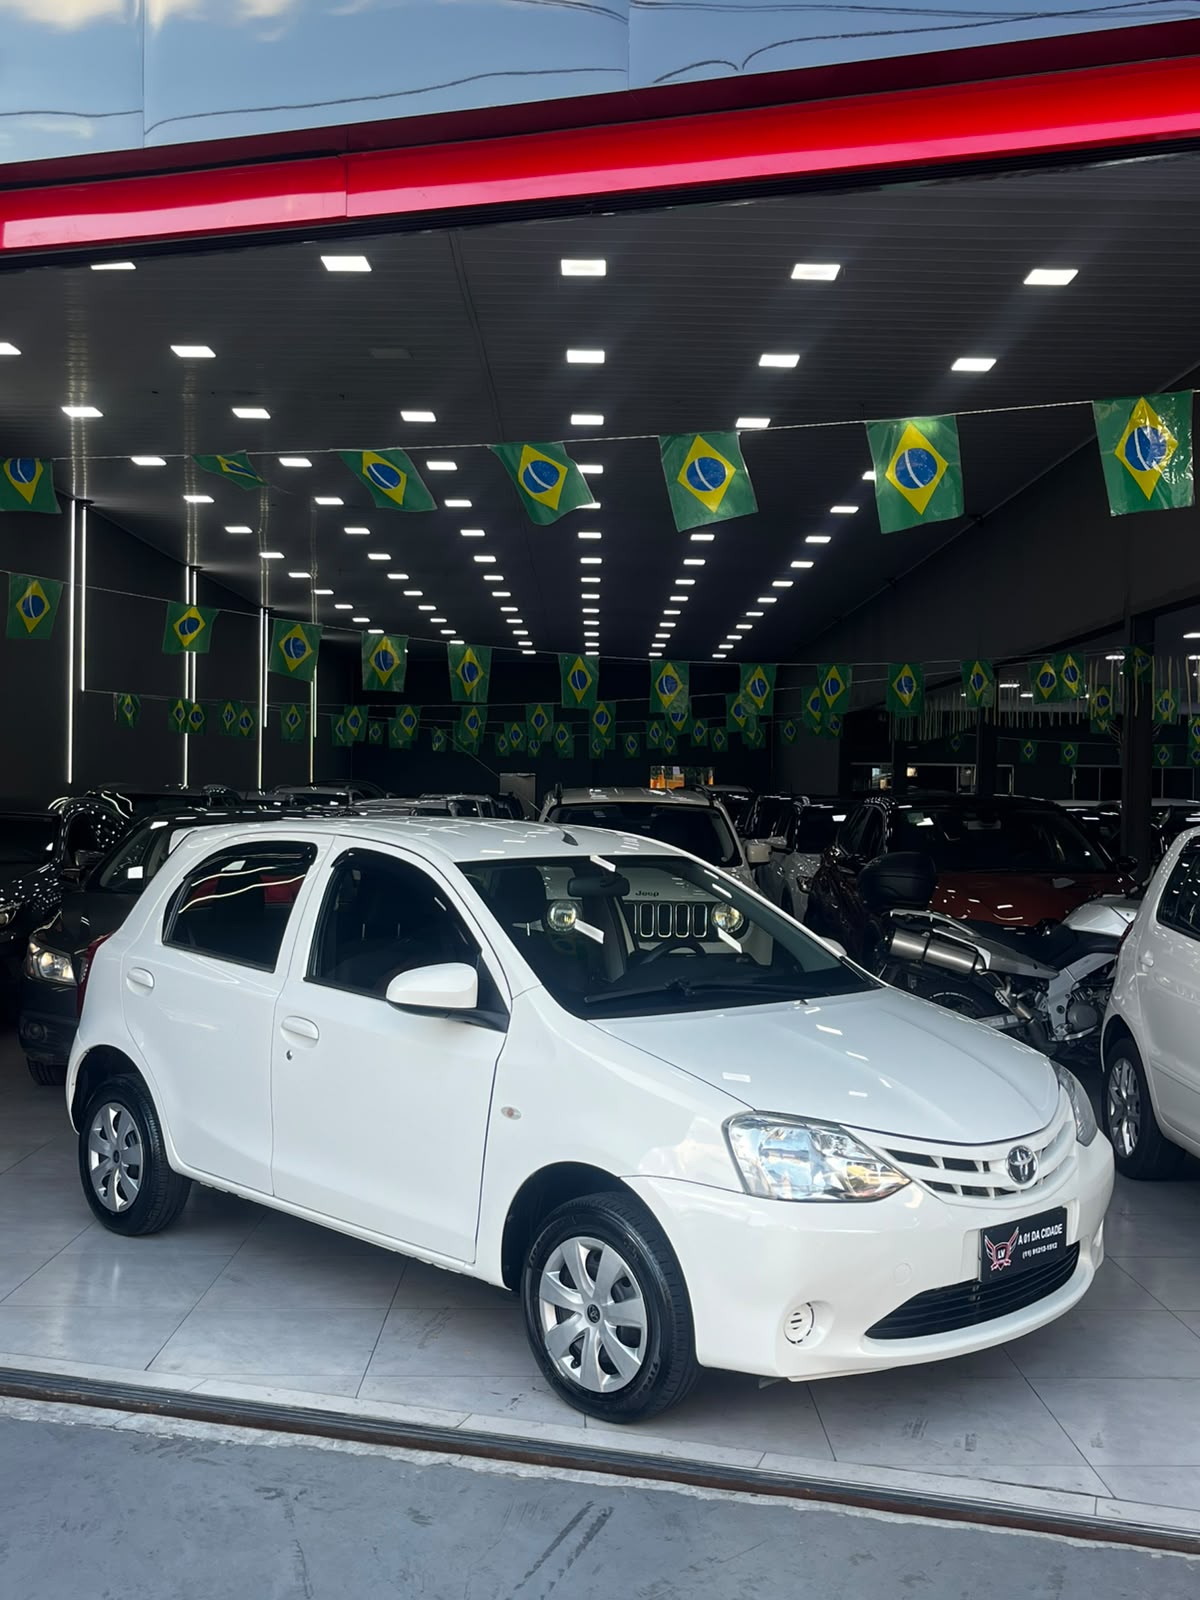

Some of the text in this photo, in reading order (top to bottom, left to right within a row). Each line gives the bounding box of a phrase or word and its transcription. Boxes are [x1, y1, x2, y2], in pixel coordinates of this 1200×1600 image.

[1018, 1223, 1063, 1245] A 01 DA CIDADE
